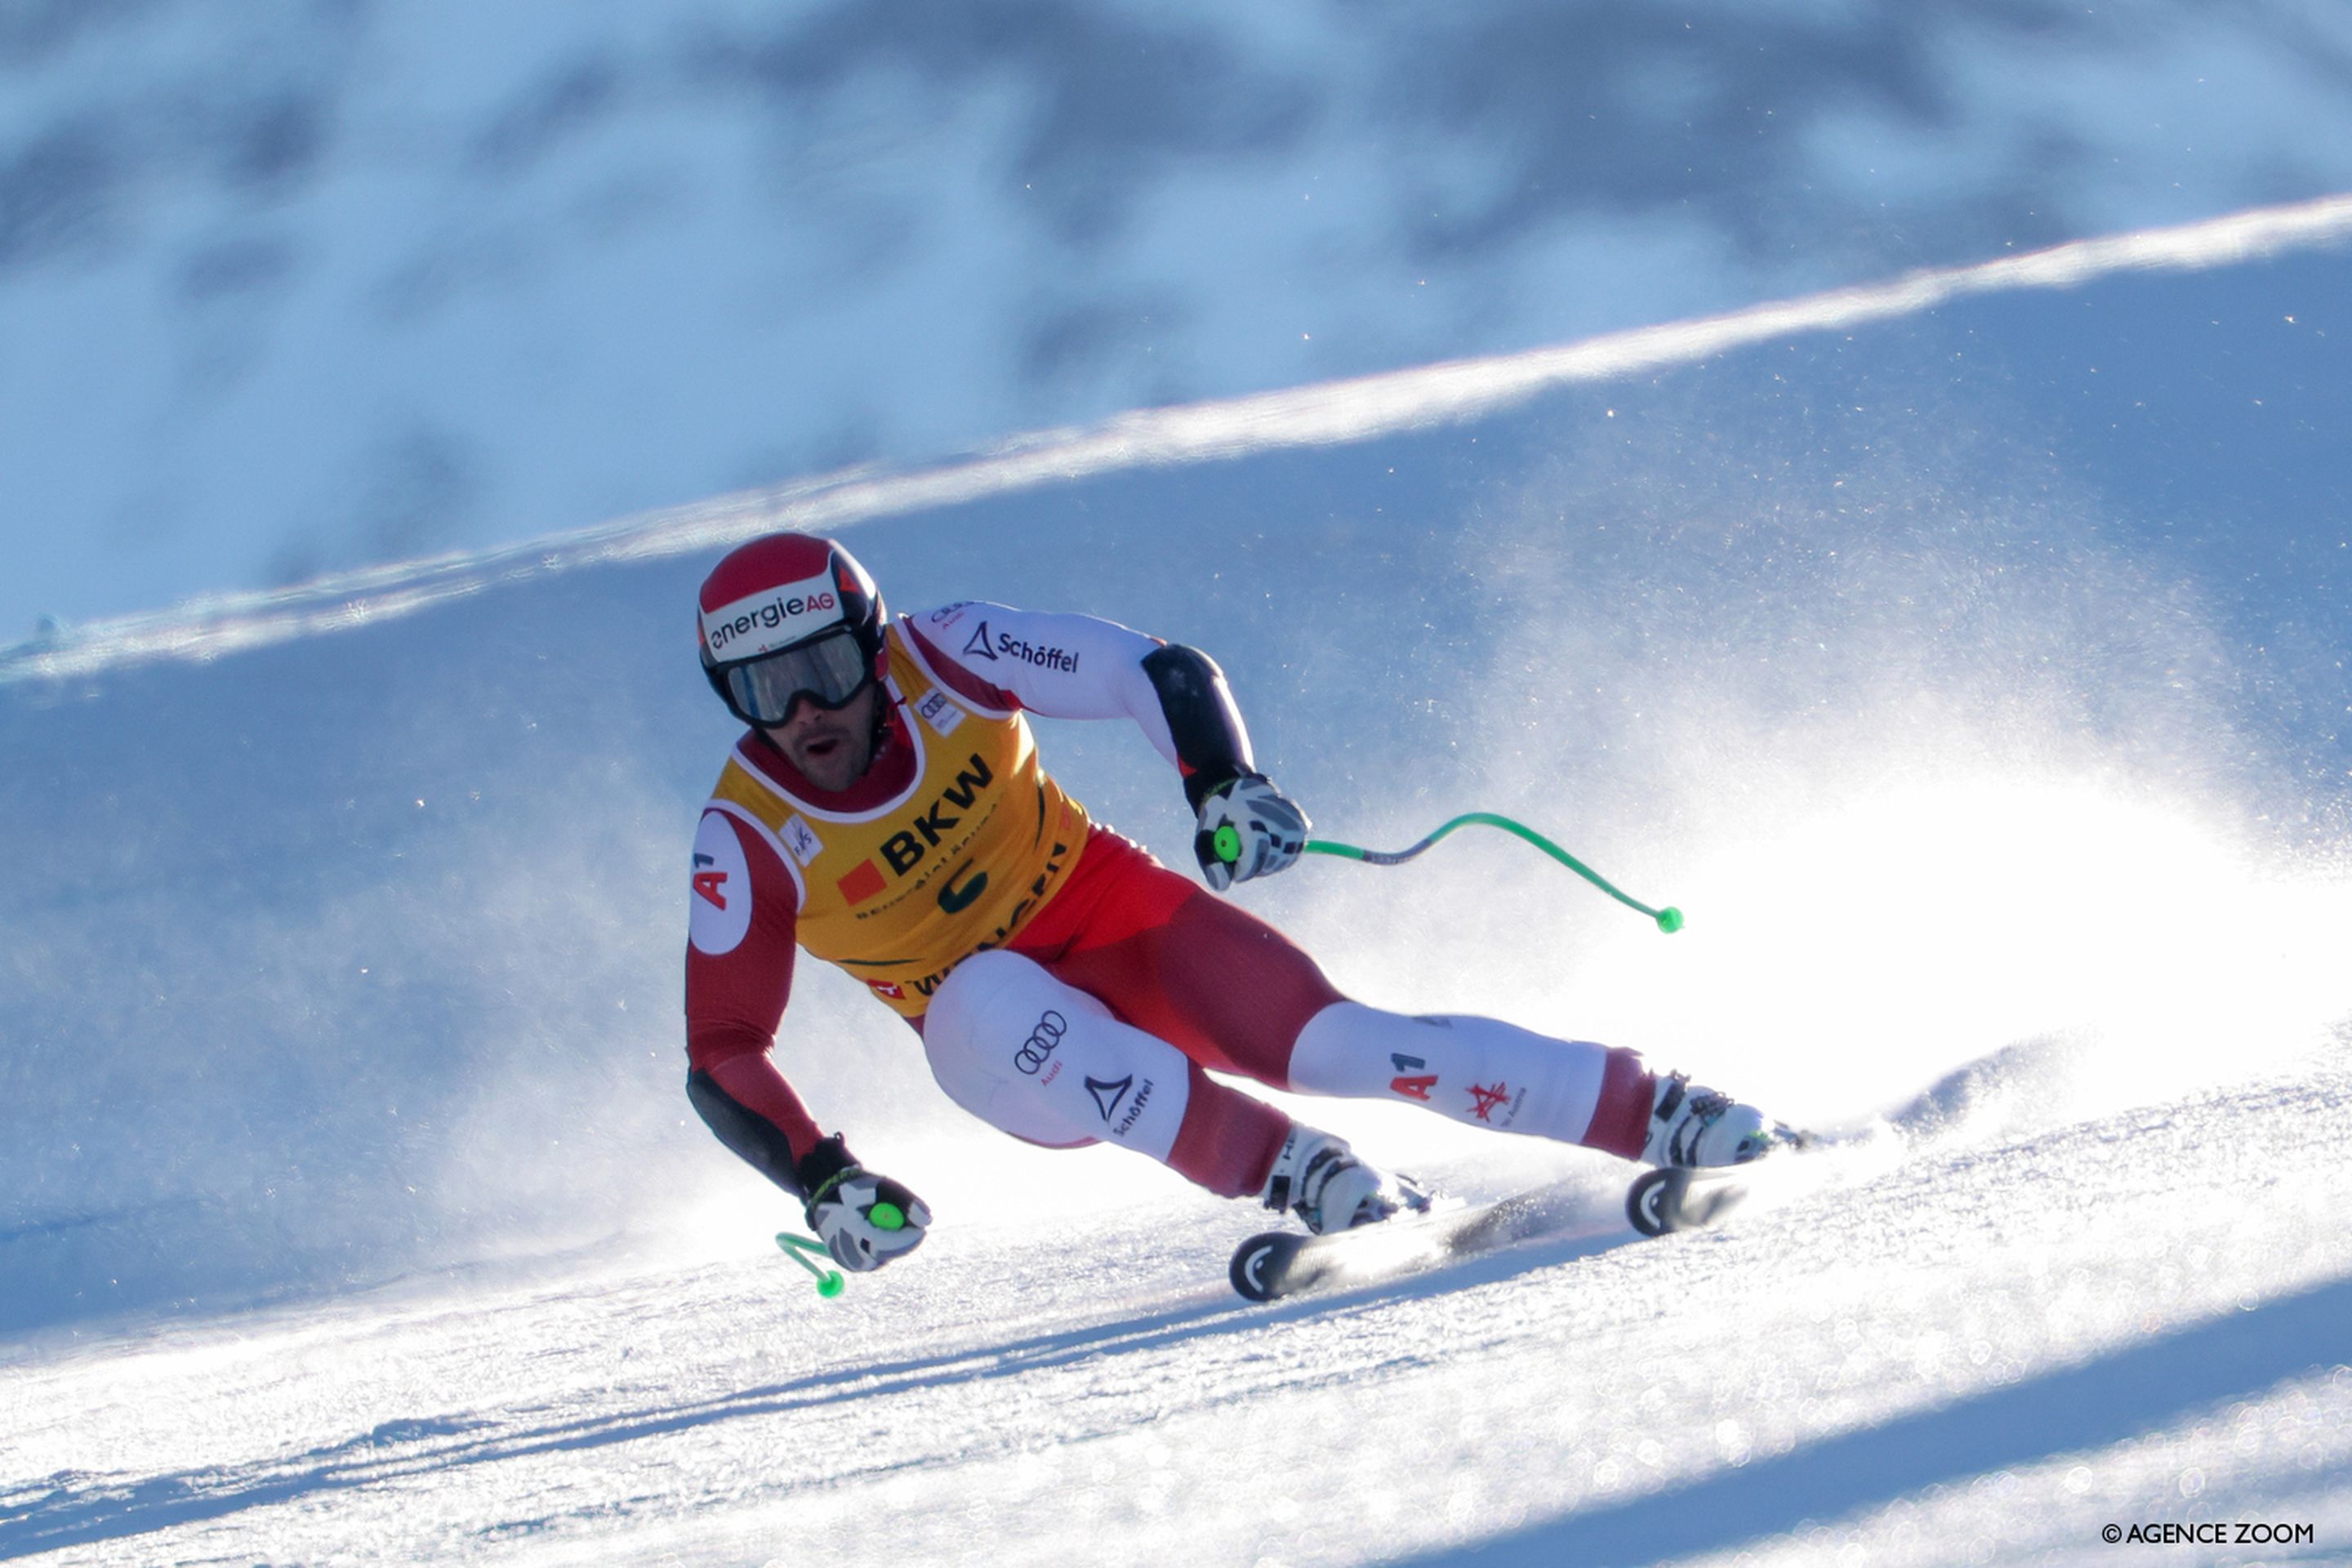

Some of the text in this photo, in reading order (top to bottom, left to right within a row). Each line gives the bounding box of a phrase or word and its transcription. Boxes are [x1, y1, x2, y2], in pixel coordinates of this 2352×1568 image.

[997, 632, 1080, 674] Schöffel
[880, 752, 994, 877] BKW
[693, 853, 728, 912] A1
[1040, 1060, 1063, 1087] Audi
[1390, 1052, 1439, 1102] A1
[1112, 1078, 1155, 1138] Schöffel
